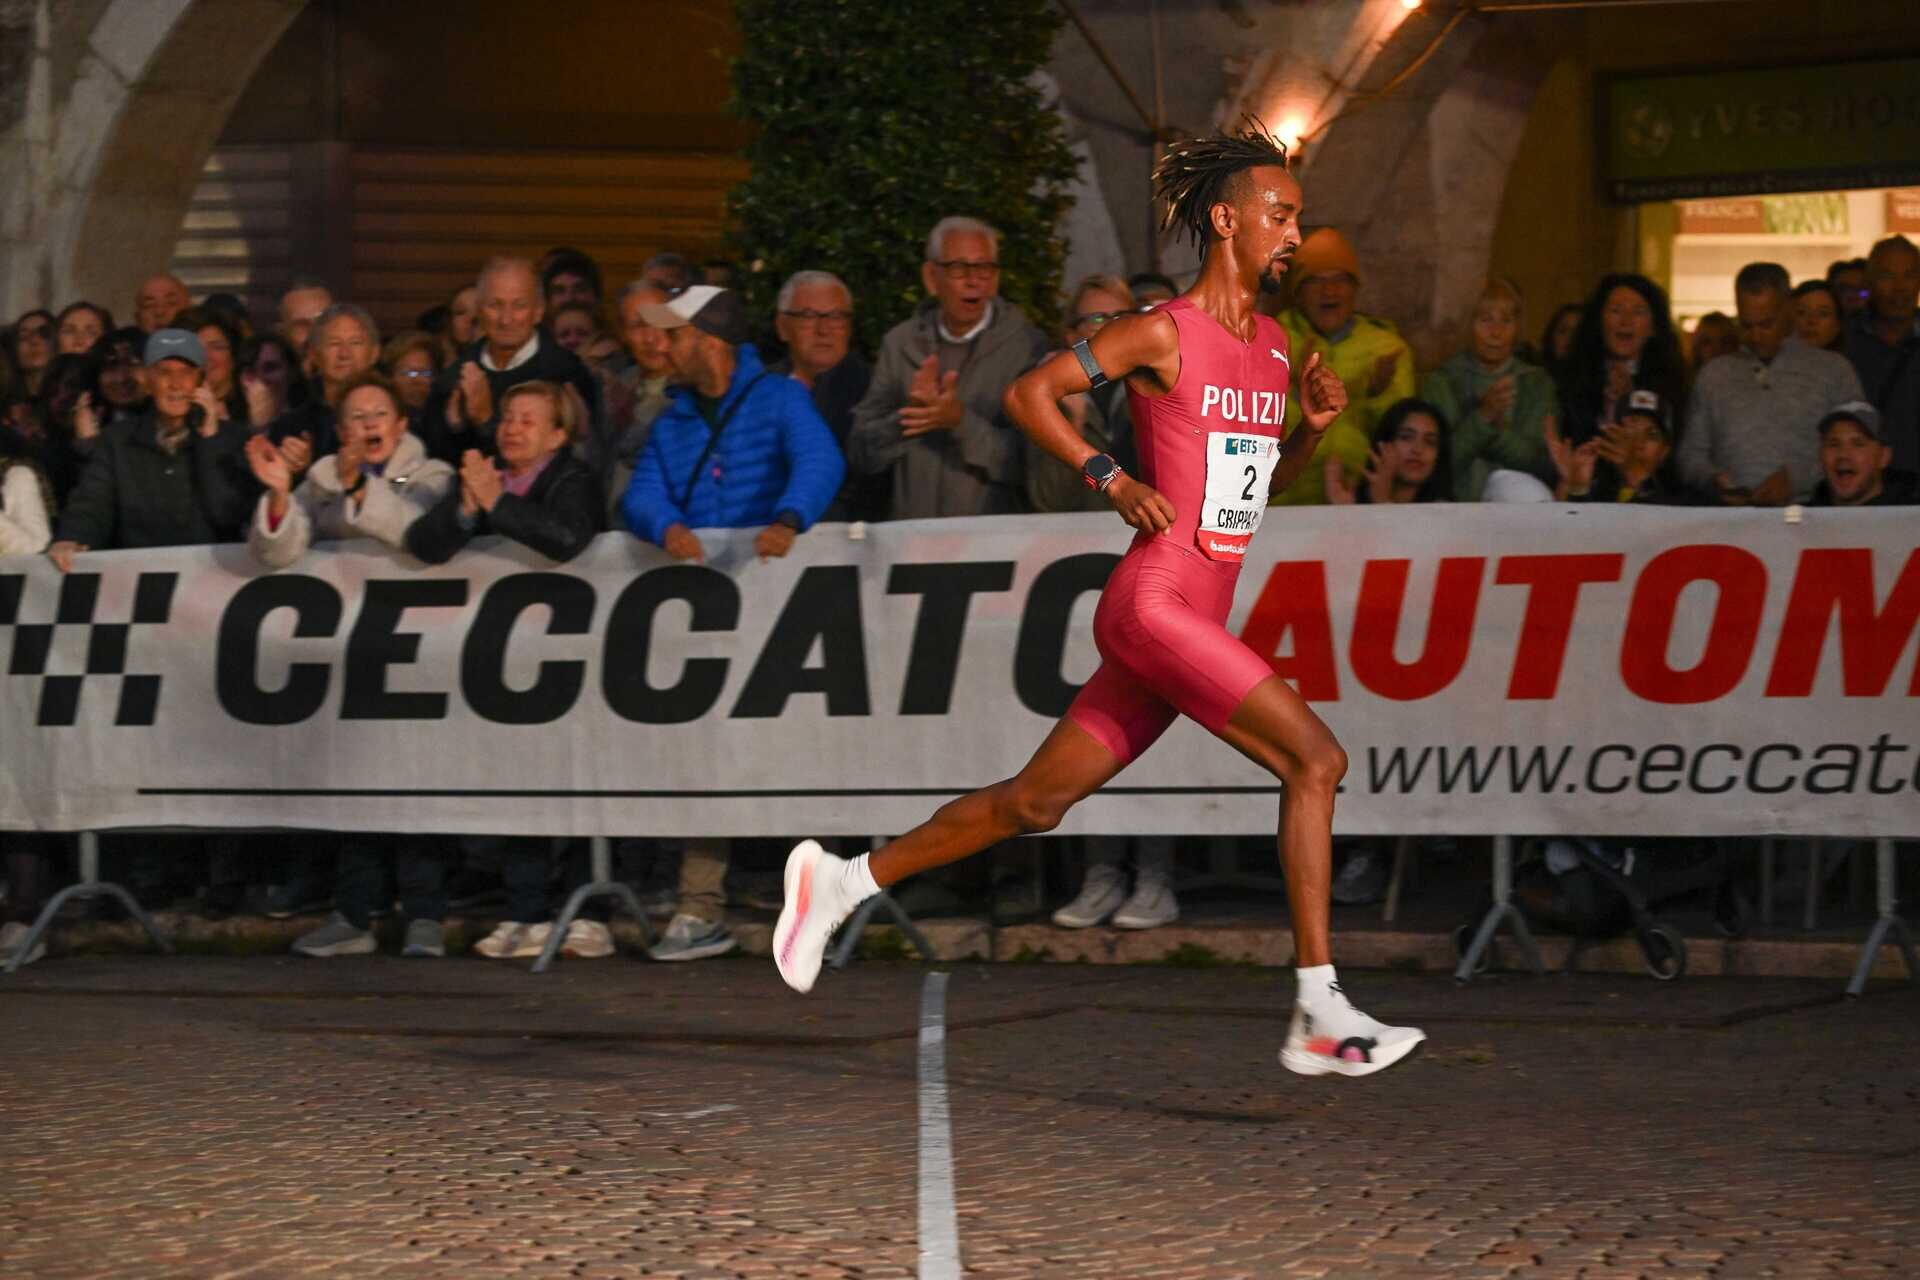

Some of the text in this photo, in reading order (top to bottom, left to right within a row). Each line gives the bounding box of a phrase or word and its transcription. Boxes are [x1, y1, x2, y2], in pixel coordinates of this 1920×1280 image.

[1240, 439, 1257, 454] ETS
[1241, 465, 1257, 500] 2
[1367, 733, 1920, 795] www.ceccat
